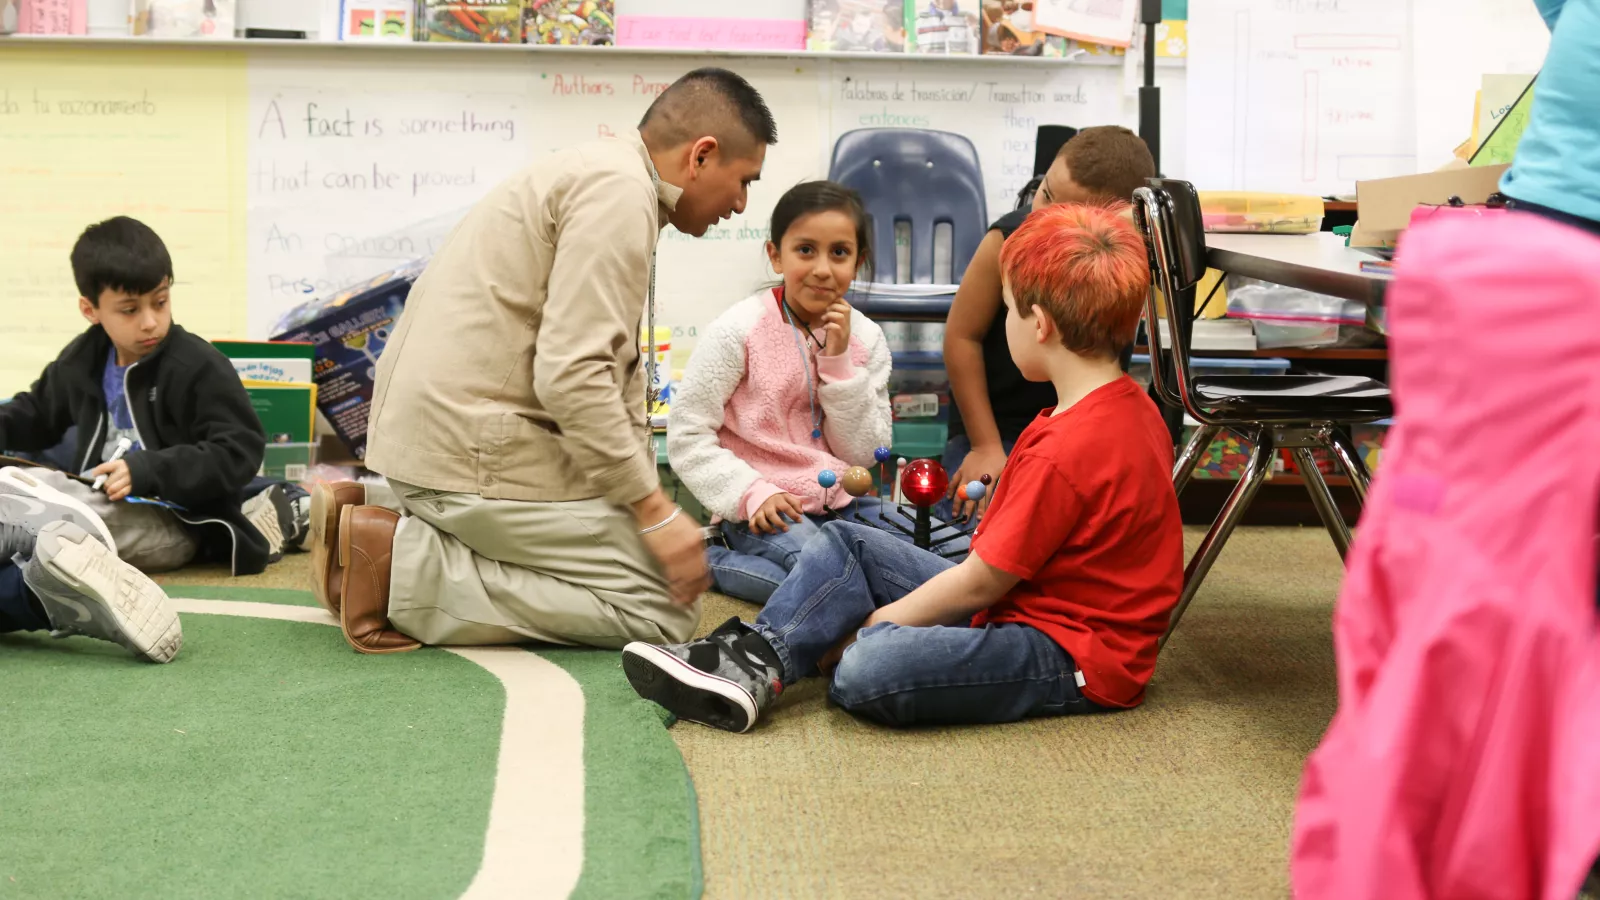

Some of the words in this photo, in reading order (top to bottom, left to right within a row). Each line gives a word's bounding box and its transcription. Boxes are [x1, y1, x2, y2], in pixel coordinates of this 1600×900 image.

[32, 87, 50, 115] tu
[840, 80, 888, 101] Palabras
[891, 84, 904, 101] de
[985, 82, 1046, 104] Transition
[1053, 82, 1087, 104] words
[258, 99, 287, 139] A
[302, 102, 355, 137] fact
[364, 119, 384, 136] is
[400, 110, 515, 141] something
[858, 106, 930, 127] entonces
[1002, 107, 1036, 129] then
[1002, 138, 1036, 152] nex
[252, 159, 311, 193] that
[322, 171, 367, 191] can
[372, 162, 400, 190] be
[264, 223, 302, 254] An
